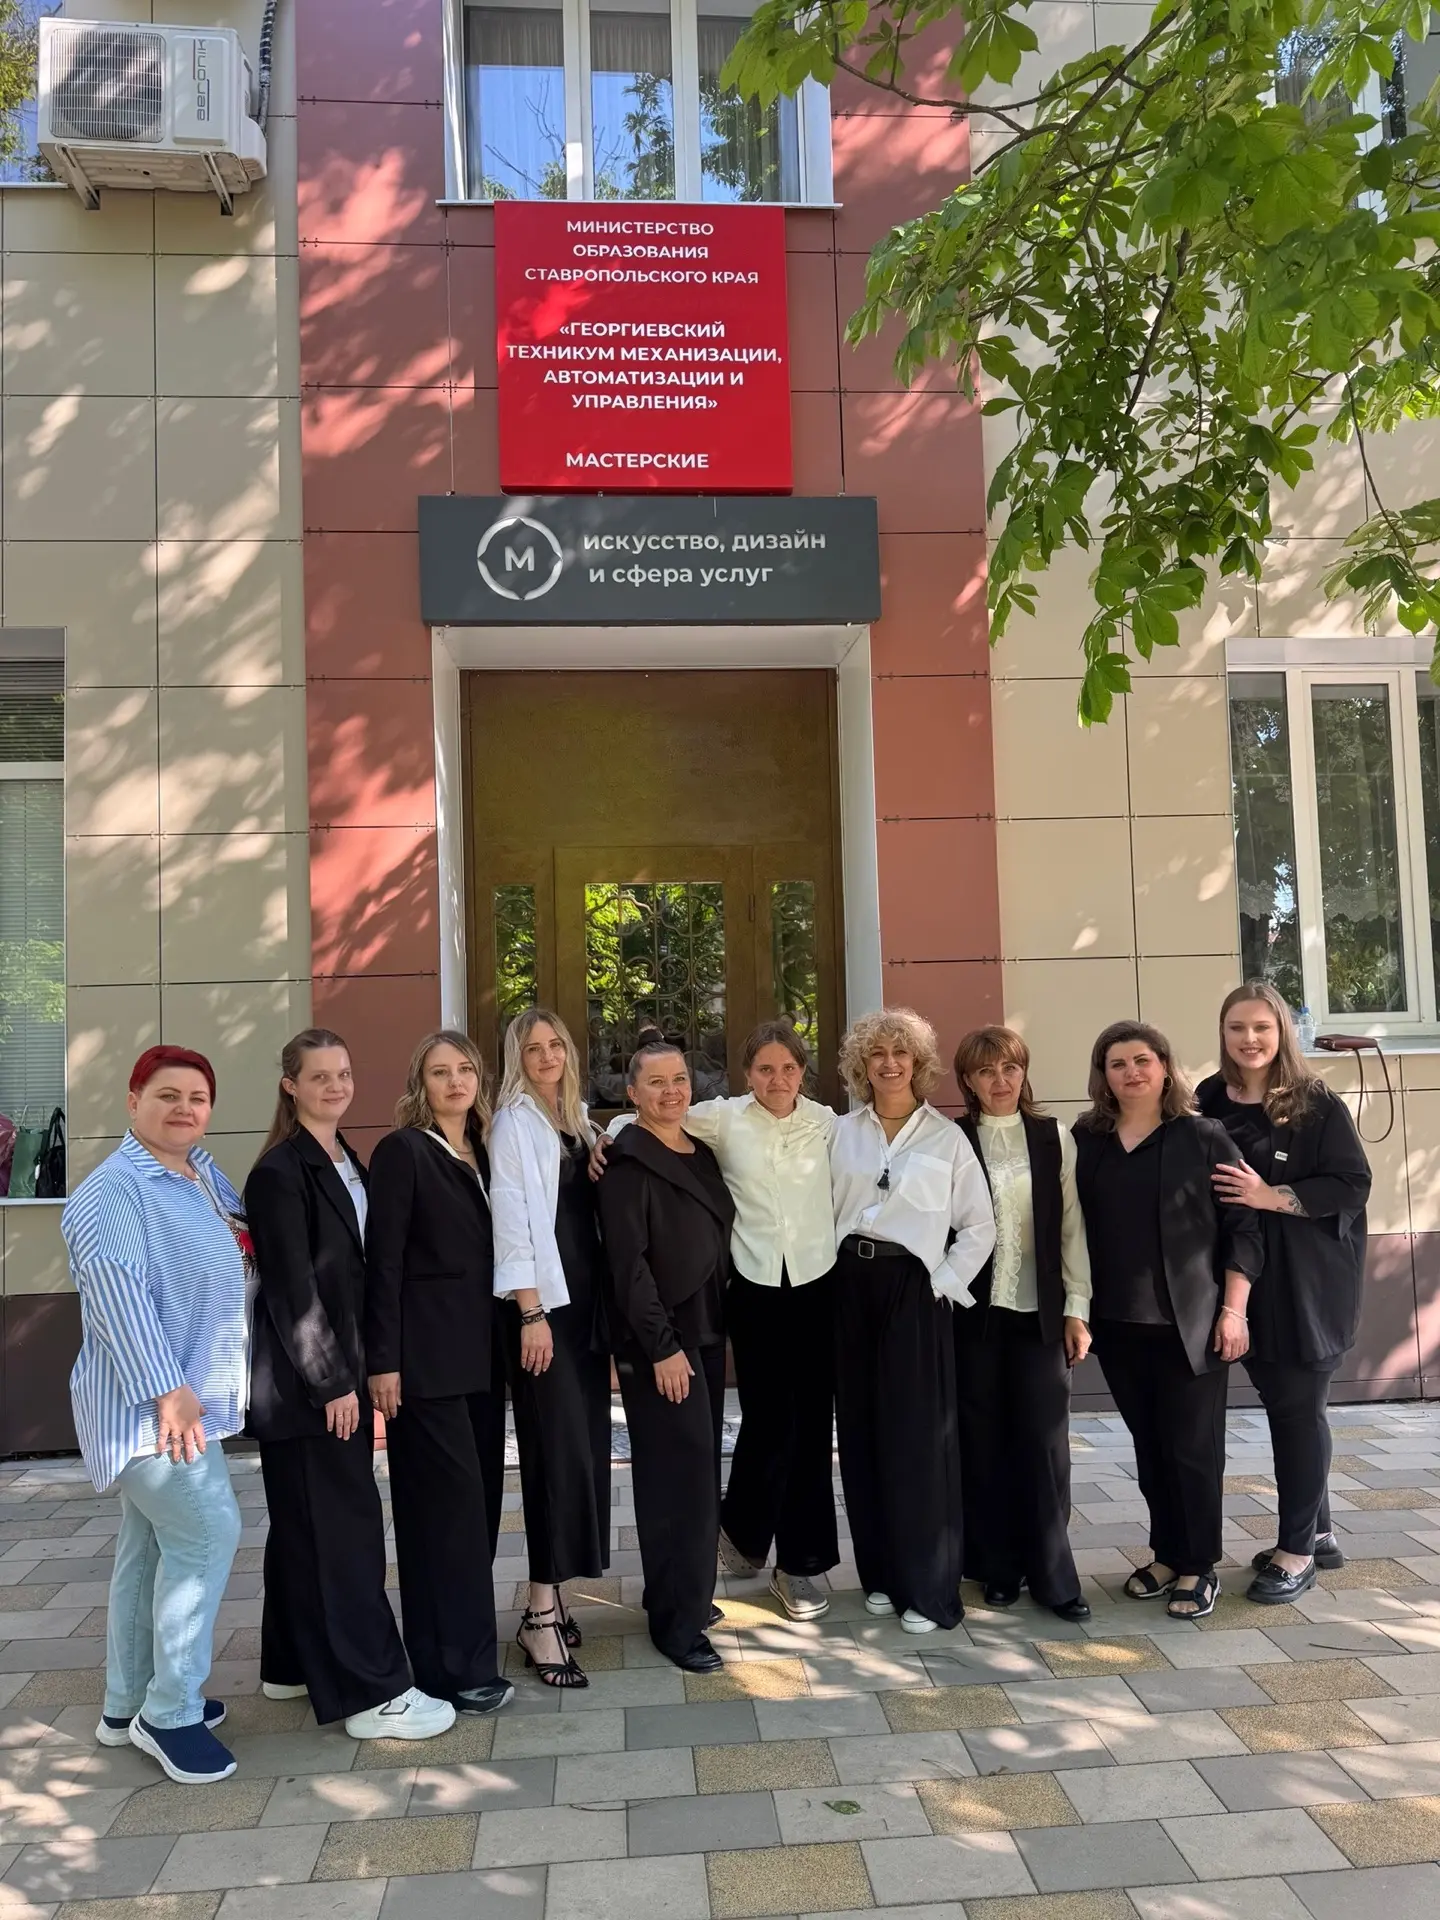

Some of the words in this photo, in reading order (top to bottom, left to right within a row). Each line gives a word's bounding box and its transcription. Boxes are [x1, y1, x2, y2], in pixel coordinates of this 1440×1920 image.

[196, 38, 207, 121] aeronik
[567, 220, 714, 236] МИНИСТЕРСТВО
[572, 244, 709, 259] ОБРАЗОВАНИЯ
[524, 268, 707, 284] СТАВРОПОЛЬСКОГО
[712, 271, 759, 284] КРАЯ
[559, 320, 725, 338] «ГЕОРГИЕВСКИЙ
[505, 345, 615, 361] ТЕХНИКУМ
[620, 347, 782, 364] МЕХАНИЗАЦИИ,
[543, 369, 724, 388] АВТОМАТИЗАЦИИ
[729, 371, 744, 386] И
[571, 394, 718, 409] УПРАВЛЕНИЯ»
[566, 452, 709, 469] МАСТЕРСКИЕ
[583, 534, 725, 555] искусство,
[731, 529, 826, 552] дизайн
[589, 568, 605, 583] и
[612, 563, 693, 588] сфера
[699, 567, 773, 587] услуг
